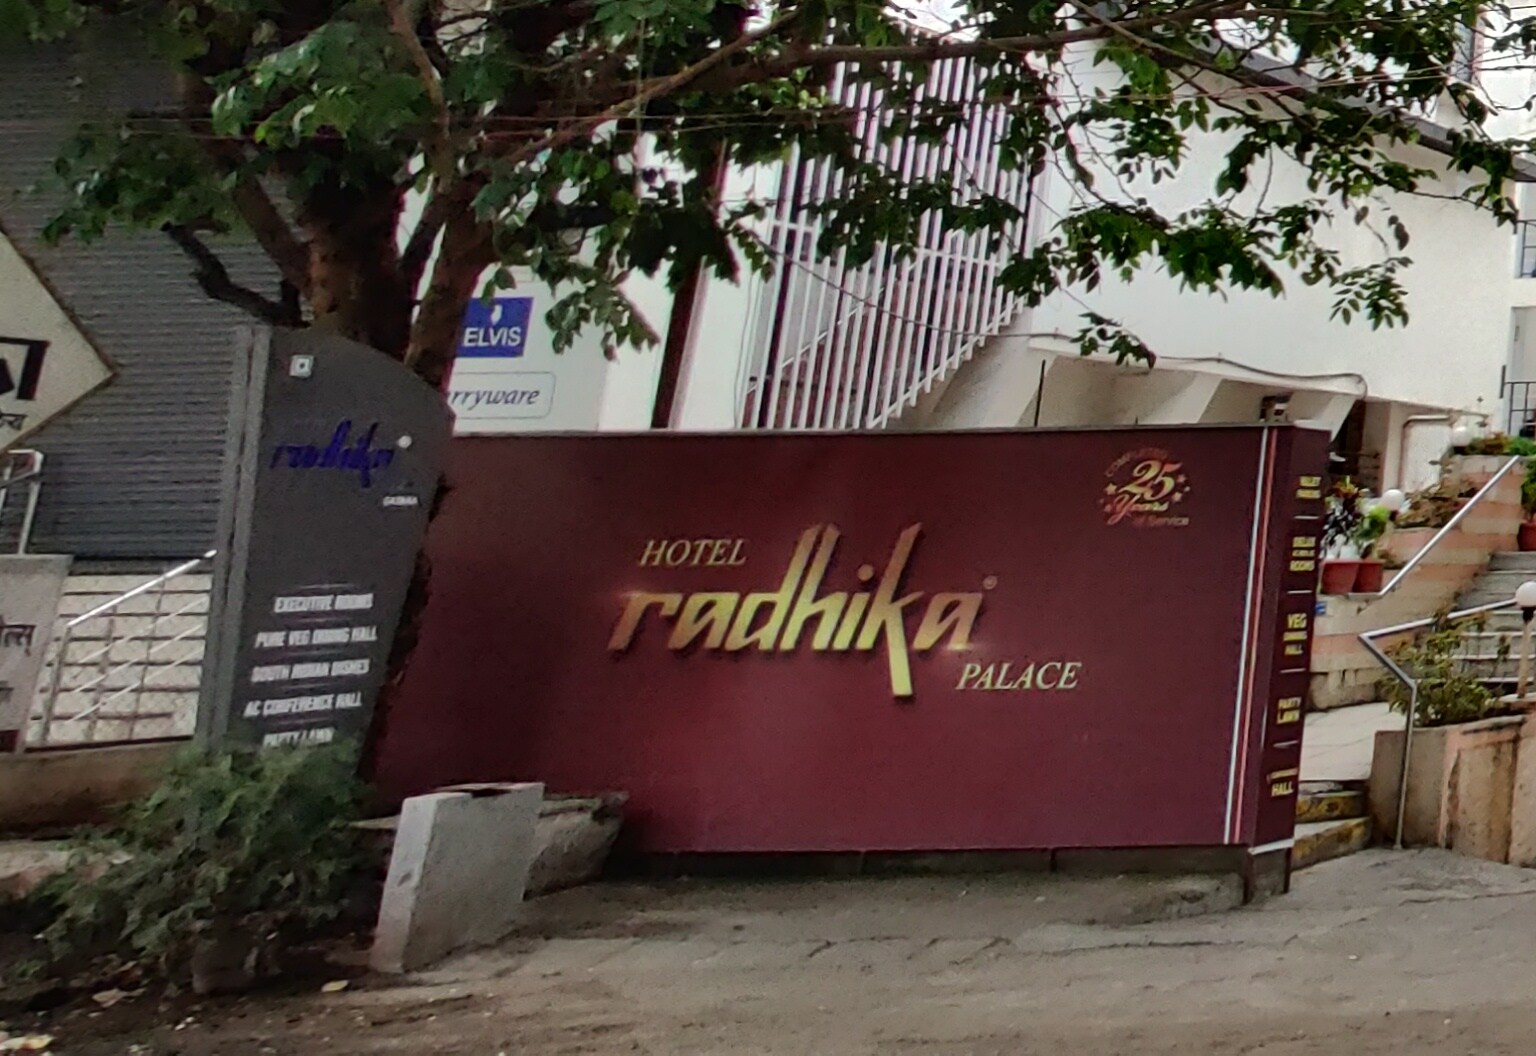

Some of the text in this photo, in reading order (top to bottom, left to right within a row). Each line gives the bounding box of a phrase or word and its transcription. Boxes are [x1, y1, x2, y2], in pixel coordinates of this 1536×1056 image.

[463, 326, 522, 348] ELVIS
[450, 390, 540, 411] rryware
[1119, 460, 1182, 500] 25
[638, 539, 748, 567] HOTEL
[607, 522, 984, 697] radhika
[1287, 613, 1307, 628] VEG
[254, 631, 288, 648] PURE
[288, 629, 311, 646] VEG
[351, 626, 378, 643] HALL
[251, 664, 291, 683] SOUTH
[955, 661, 1082, 690] PALACE
[243, 700, 261, 718] AC
[335, 692, 362, 709] HALL
[1272, 781, 1295, 797] HALL
